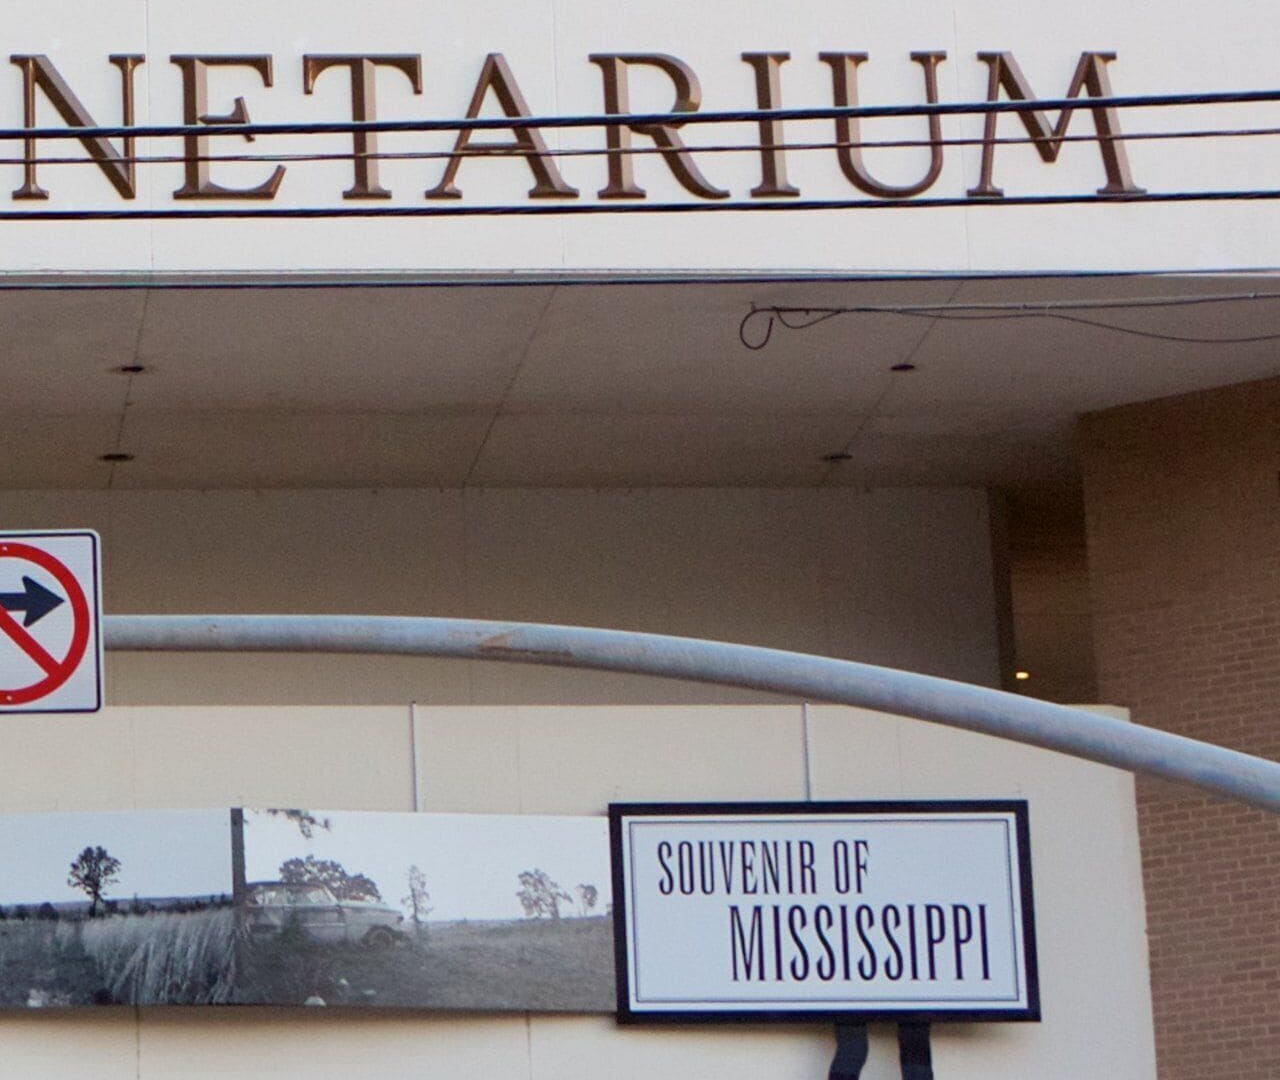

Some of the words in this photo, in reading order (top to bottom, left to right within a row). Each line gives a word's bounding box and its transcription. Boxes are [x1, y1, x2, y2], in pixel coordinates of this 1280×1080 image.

[656, 839, 818, 896] SOUVENIR
[833, 839, 870, 895] OF
[728, 903, 992, 982] MISSISSIPPI
